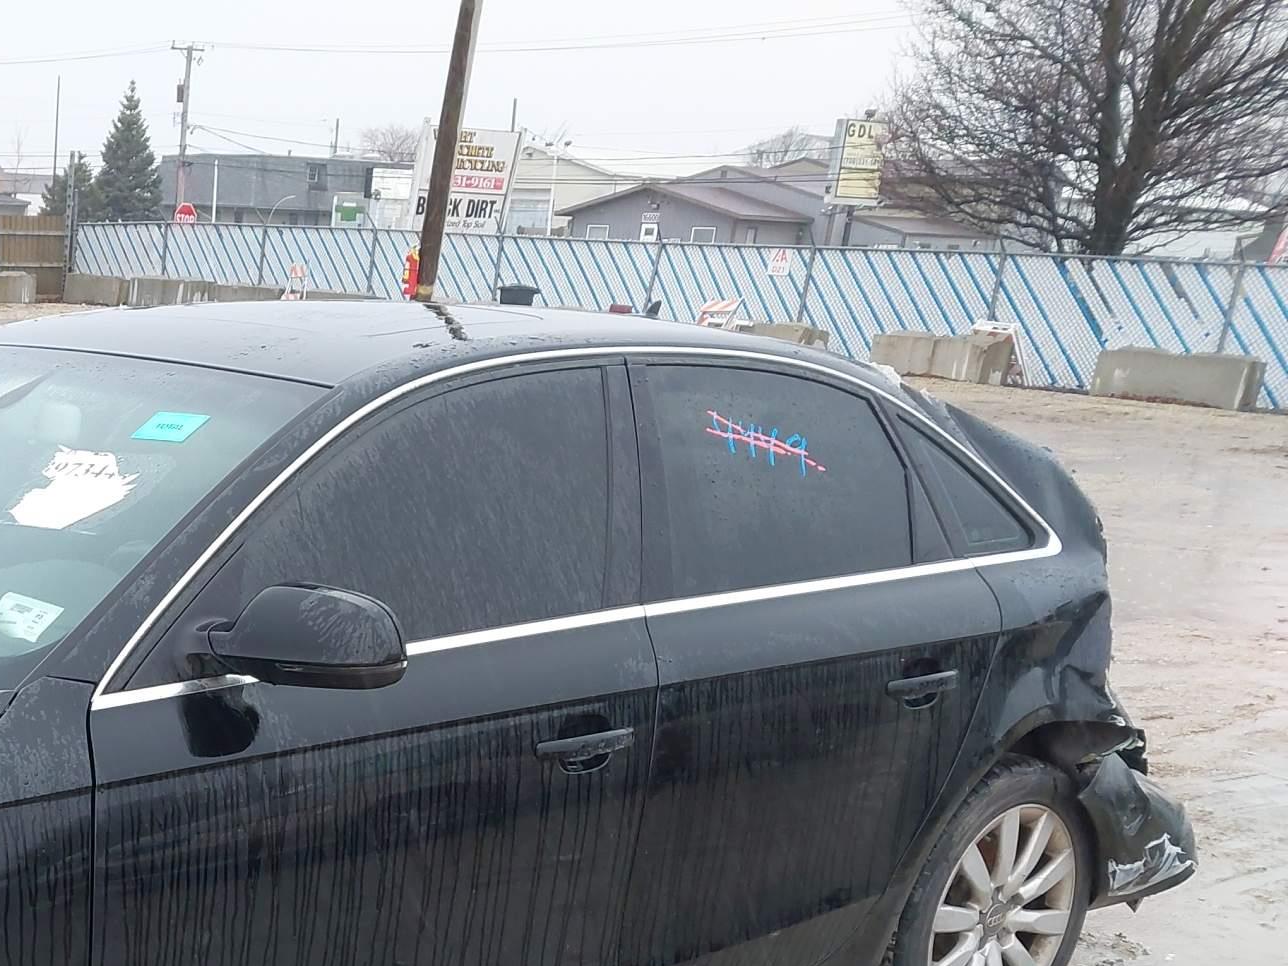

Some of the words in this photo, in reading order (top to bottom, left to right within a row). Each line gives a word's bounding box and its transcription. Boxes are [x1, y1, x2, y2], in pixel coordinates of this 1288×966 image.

[455, 158, 505, 172] ECYCLING
[453, 175, 496, 189] 31-9161
[465, 198, 497, 219] DIRT
[176, 213, 195, 223] STOP
